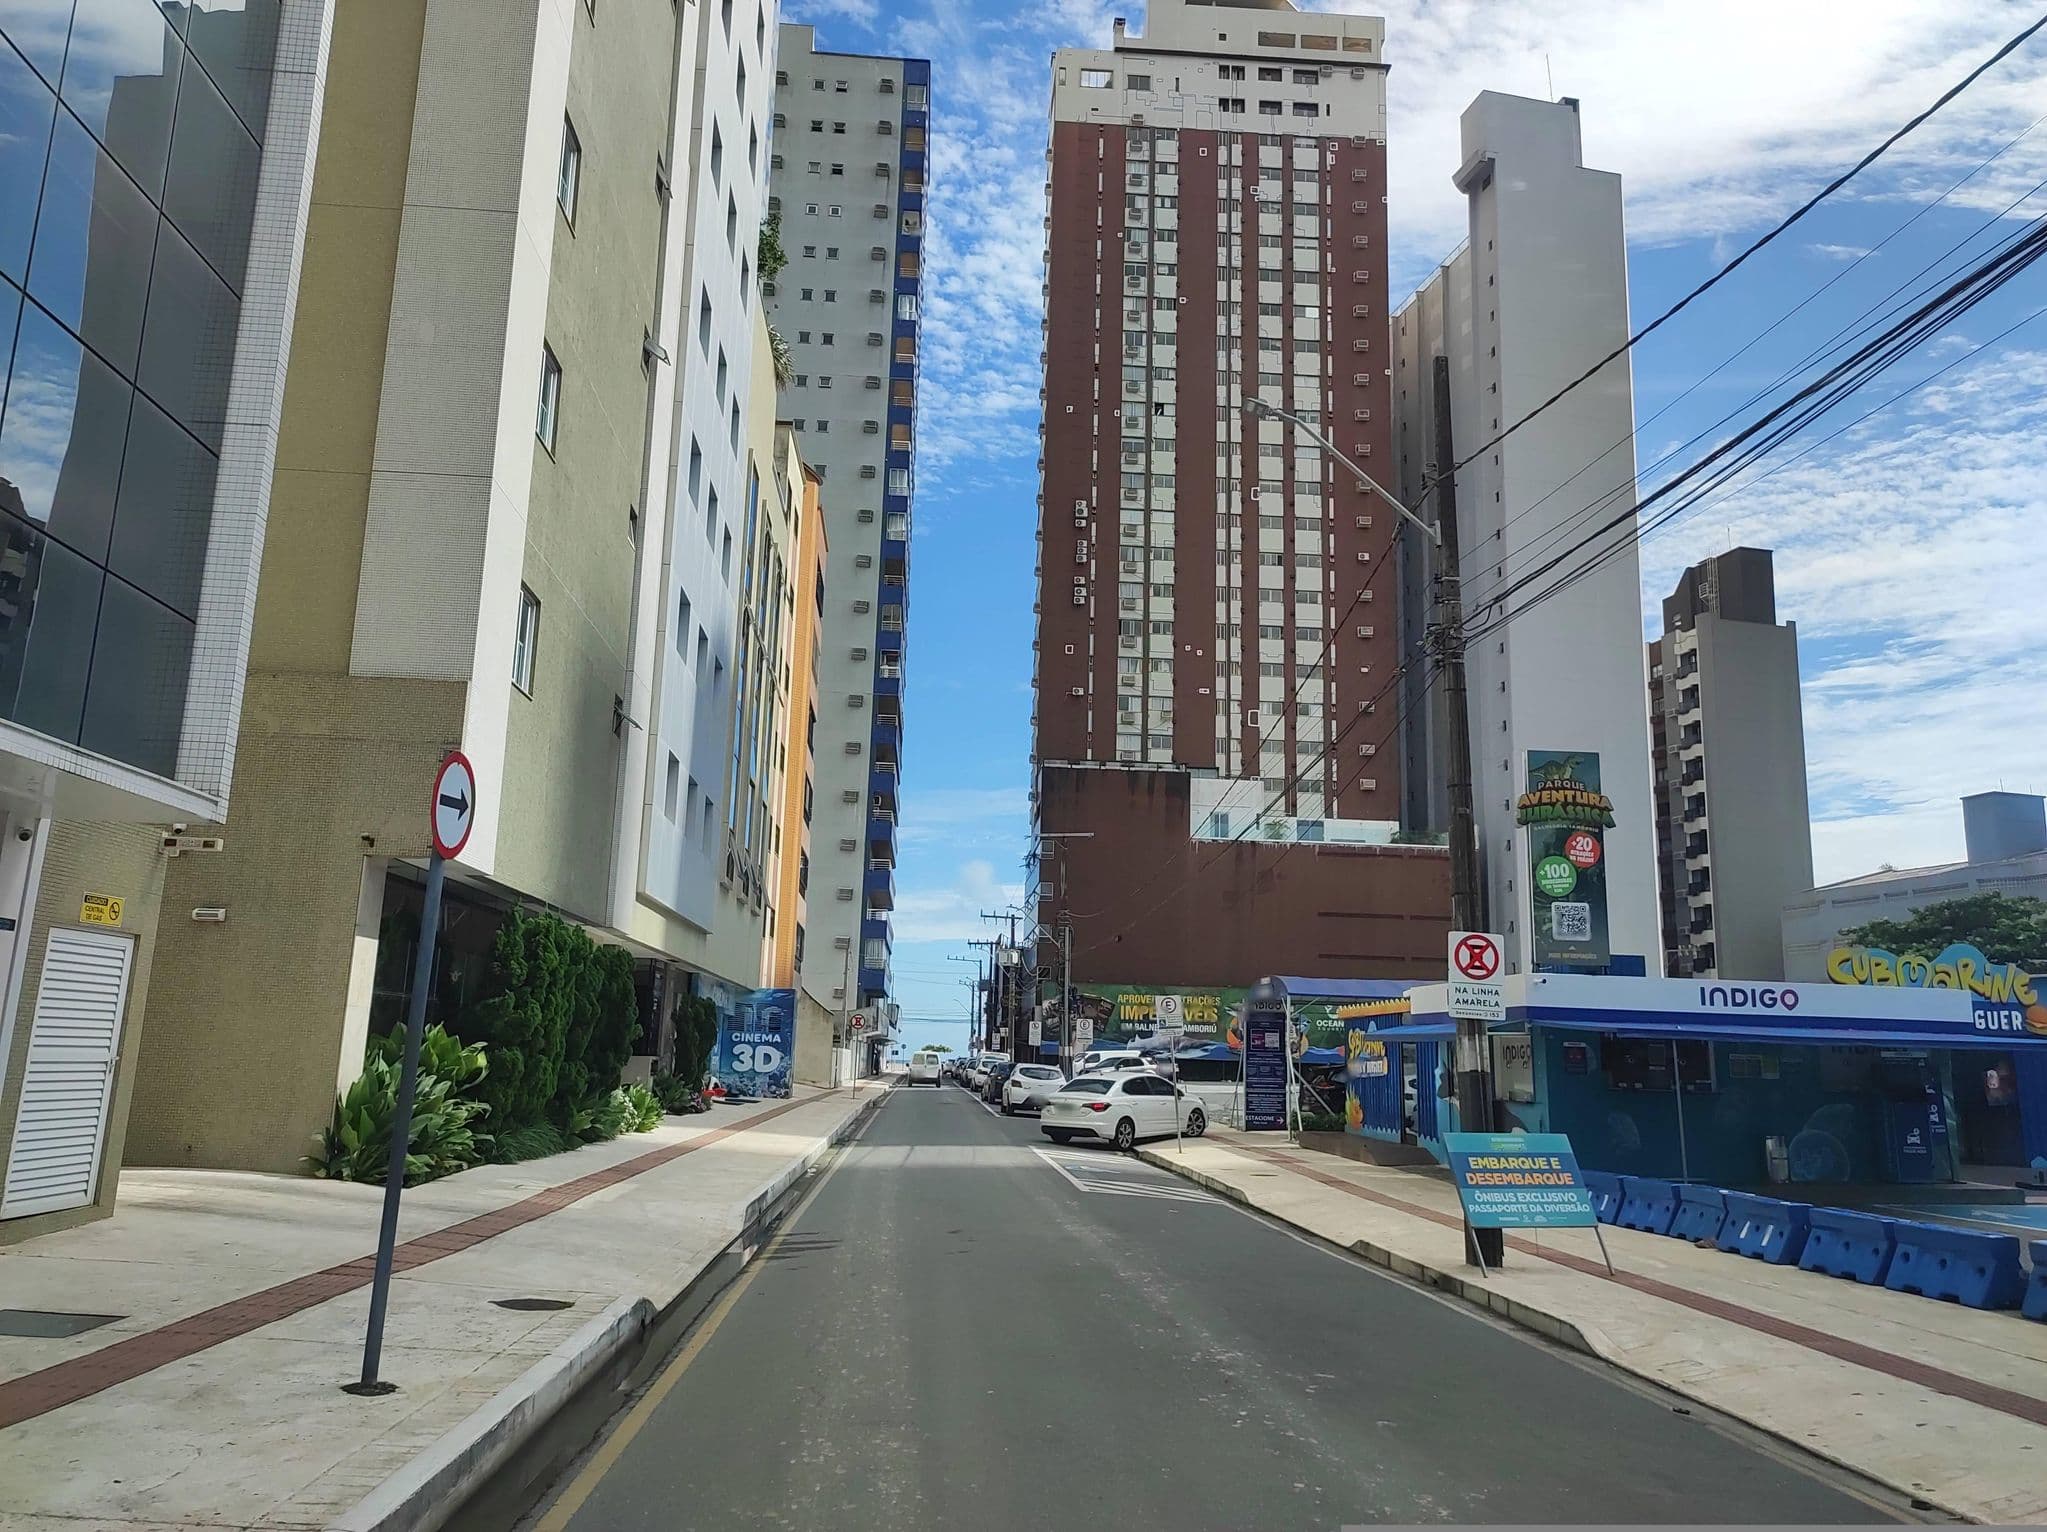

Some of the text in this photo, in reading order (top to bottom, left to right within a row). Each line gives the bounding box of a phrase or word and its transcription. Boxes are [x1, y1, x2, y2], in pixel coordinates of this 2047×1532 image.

[1538, 780, 1585, 790] PARQUE
[1518, 789, 1613, 811] AVENTURA
[1571, 836, 1593, 852] +20
[1540, 863, 1569, 879] +100
[1455, 986, 1500, 996] NA LINHA
[1455, 998, 1500, 1008] AMARELA
[1700, 986, 1799, 1011] INDIGO
[1316, 1019, 1345, 1028] OCEAN
[1974, 1009, 2022, 1031] GUER
[1183, 1023, 1217, 1033] AMBORIÚ
[731, 1032, 782, 1043] CINEMA
[731, 1044, 784, 1073] 3D
[1468, 1157, 1562, 1169] EMBARQUE E
[1465, 1172, 1575, 1185] DESEMBARQUE
[1475, 1190, 1578, 1203] ÔNIBUS EXCLUSIVO
[1468, 1201, 1591, 1213] PASSAPORTE DA DIVERSÃO
